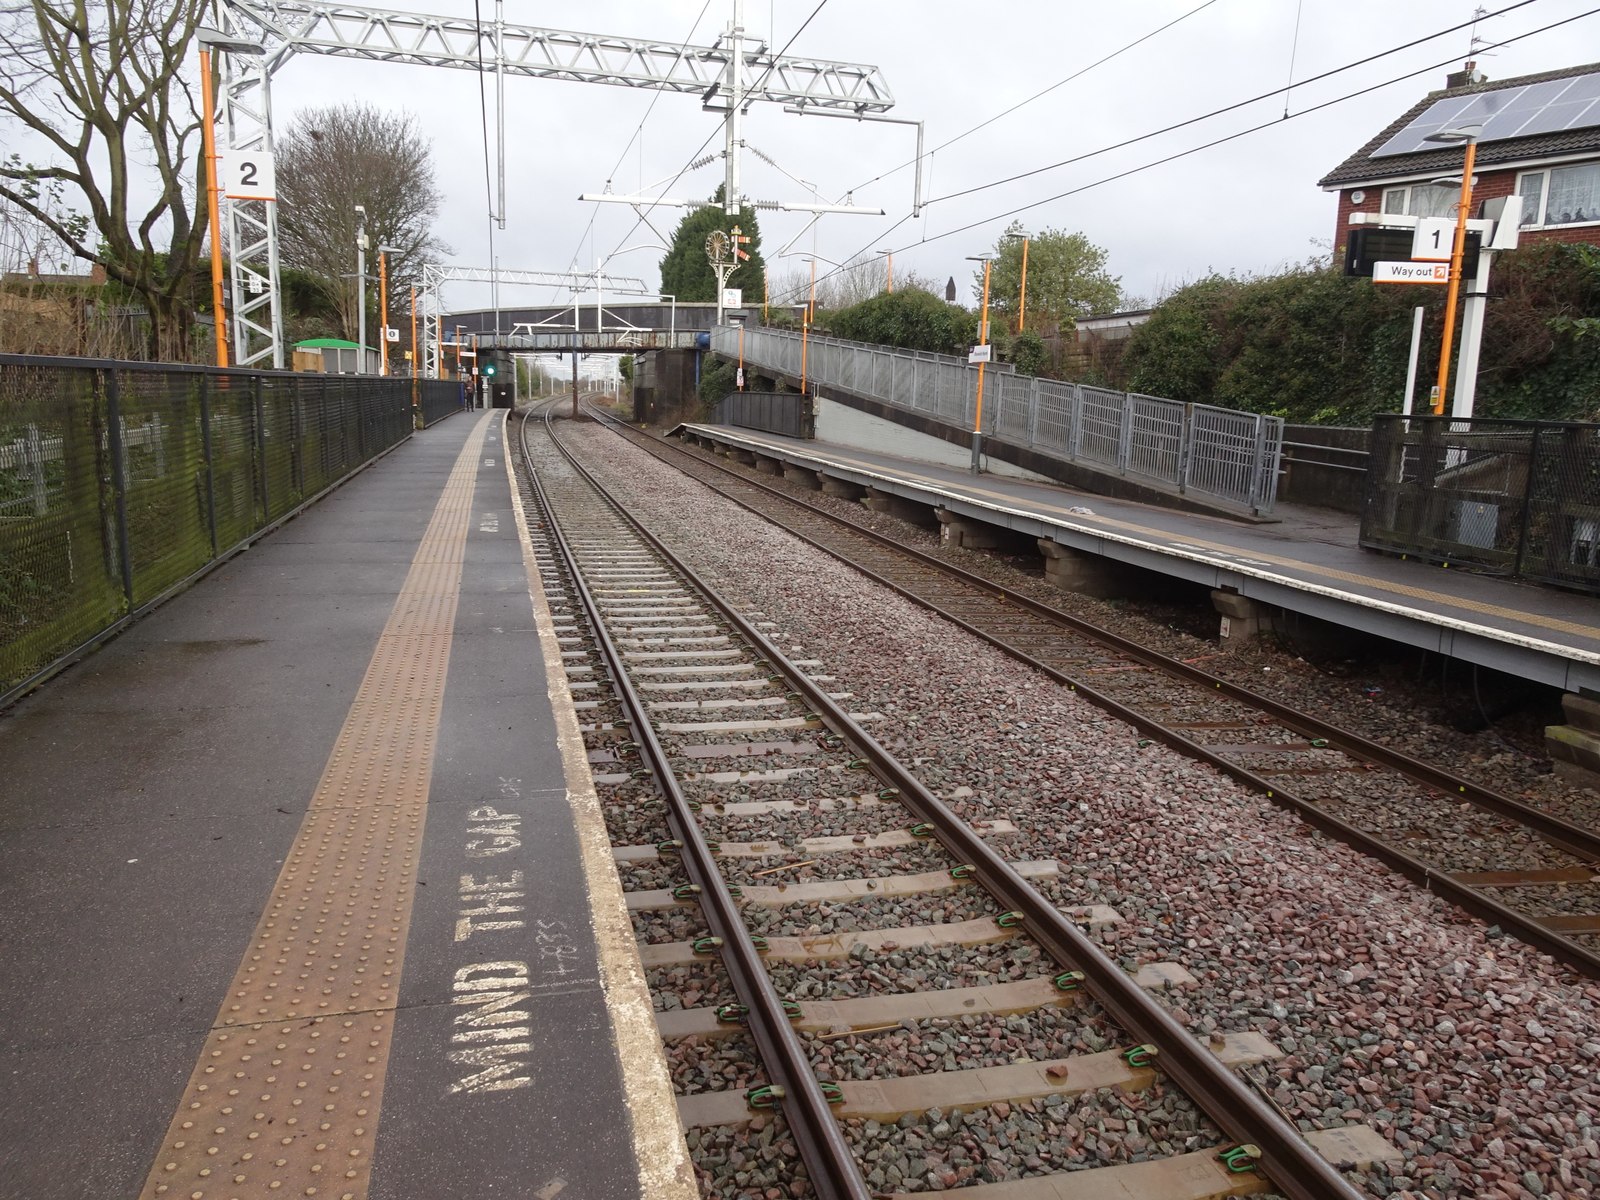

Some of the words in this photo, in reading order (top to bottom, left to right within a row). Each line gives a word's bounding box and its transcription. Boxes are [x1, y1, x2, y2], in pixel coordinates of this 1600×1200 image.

[240, 162, 258, 186] 2
[1432, 229, 1440, 249] 1
[1391, 266, 1413, 278] Way
[1416, 268, 1432, 276] out
[465, 805, 522, 858] GAP
[454, 869, 526, 942] THE
[450, 960, 533, 1094] MIND
